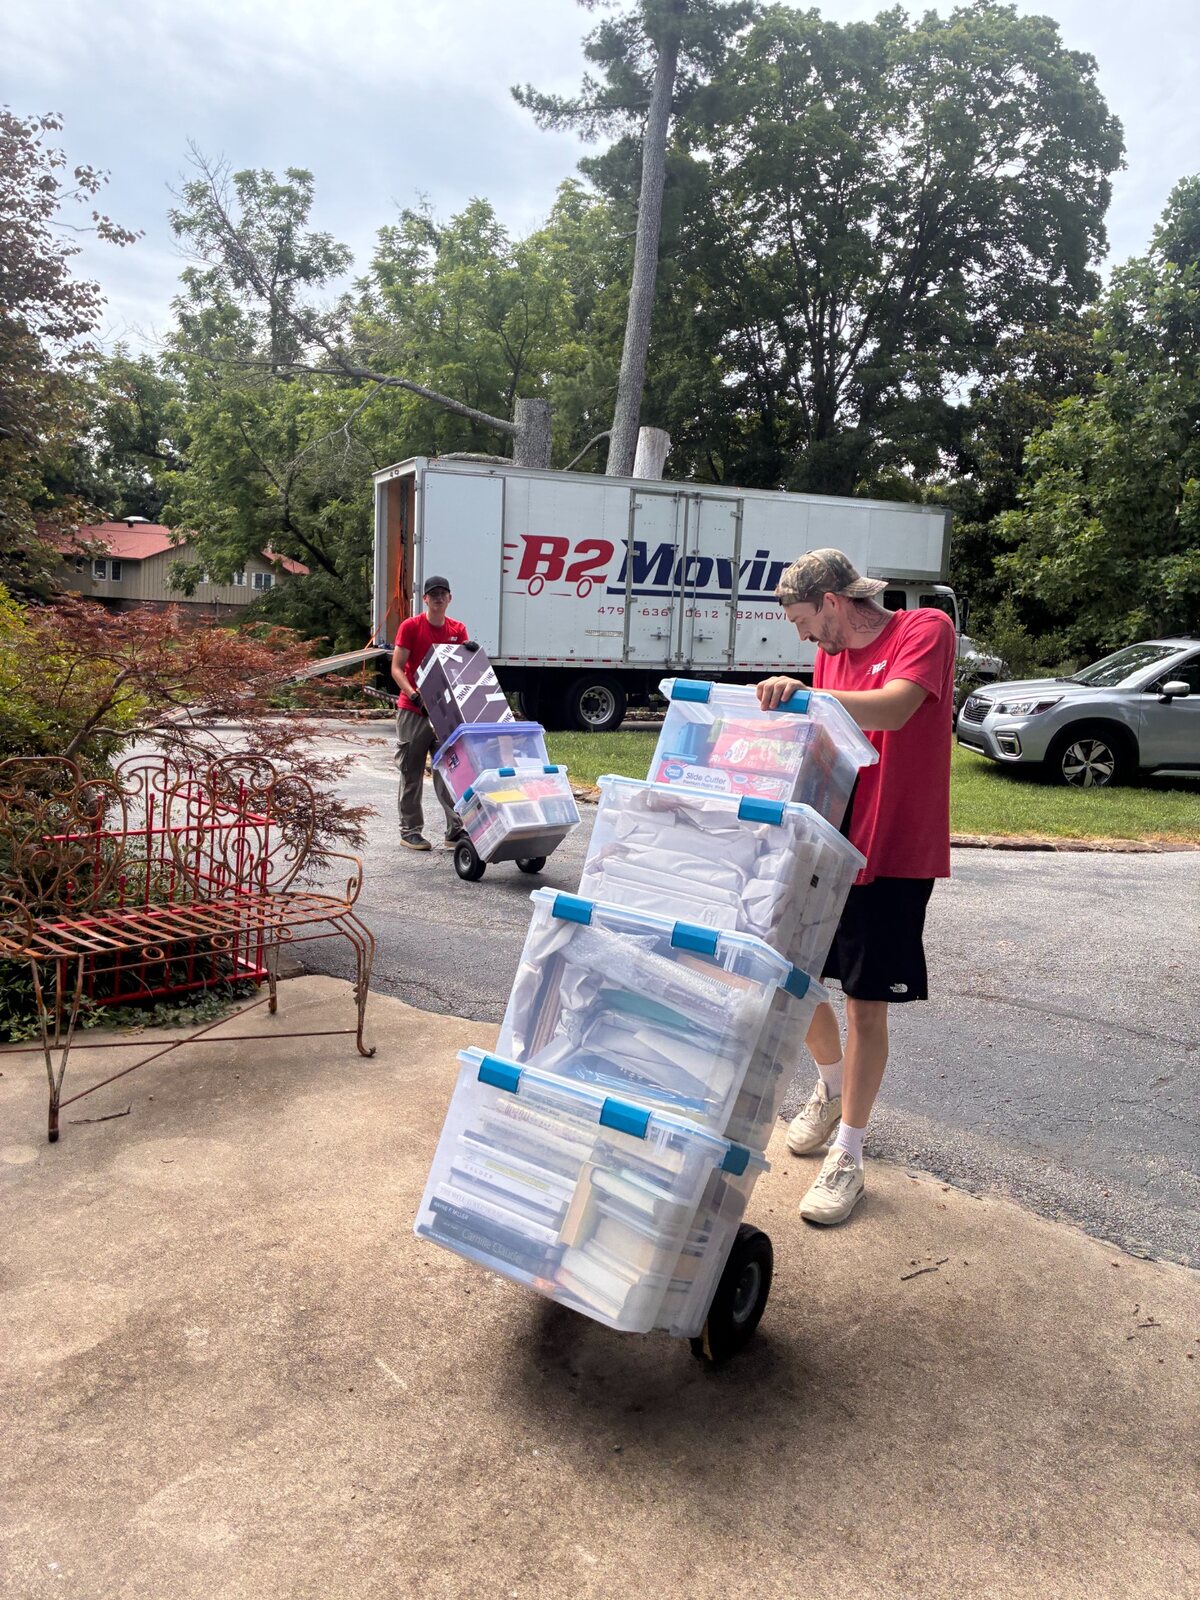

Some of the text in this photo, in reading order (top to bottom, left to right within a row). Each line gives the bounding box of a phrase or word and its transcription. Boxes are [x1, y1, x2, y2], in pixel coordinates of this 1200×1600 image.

[516, 534, 793, 591] B2 Movin
[455, 685, 472, 702] WINE
[685, 772, 703, 781] Slide
[704, 775, 727, 785] Cutter
